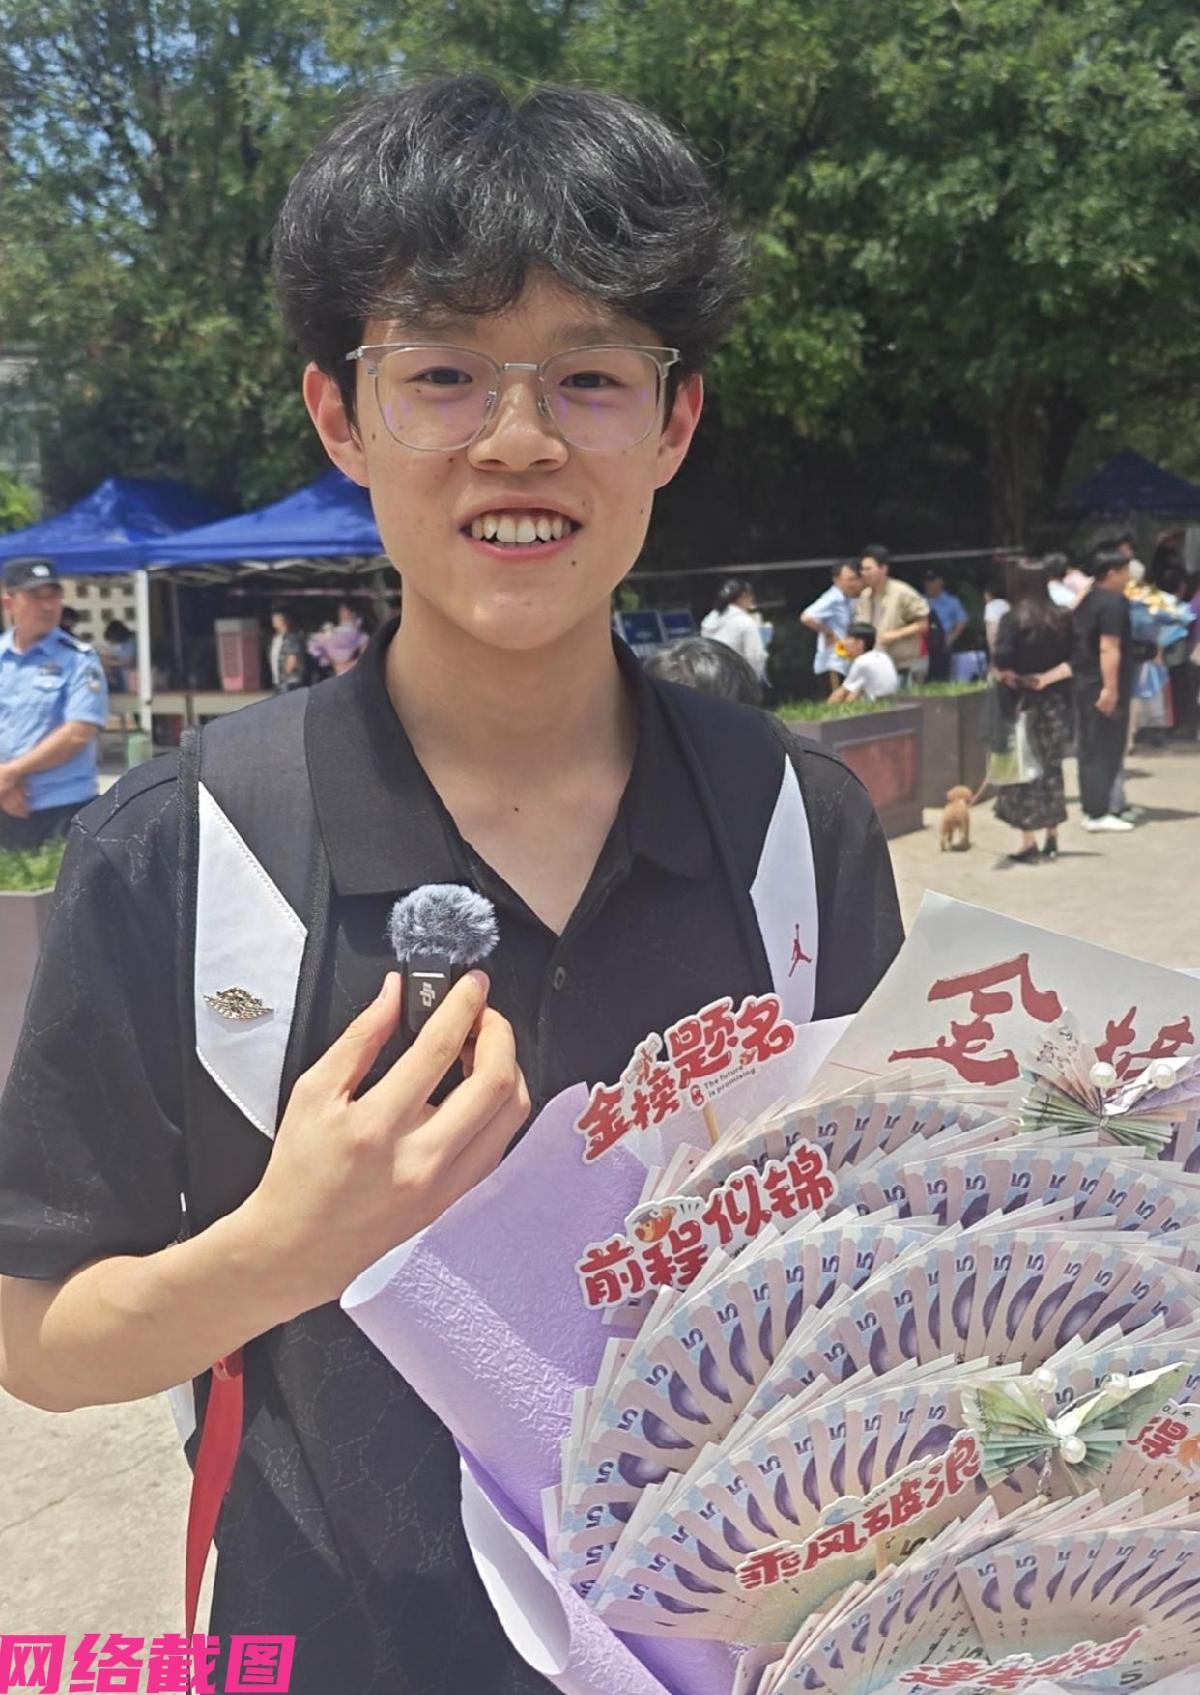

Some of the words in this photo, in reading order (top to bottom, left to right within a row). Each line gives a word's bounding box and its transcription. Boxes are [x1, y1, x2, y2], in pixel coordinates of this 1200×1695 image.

[419, 982, 436, 1008] dji
[578, 999, 794, 1160] 金榜题名
[580, 1145, 833, 1306] 前程似锦
[739, 1437, 980, 1589] 乘风破浪
